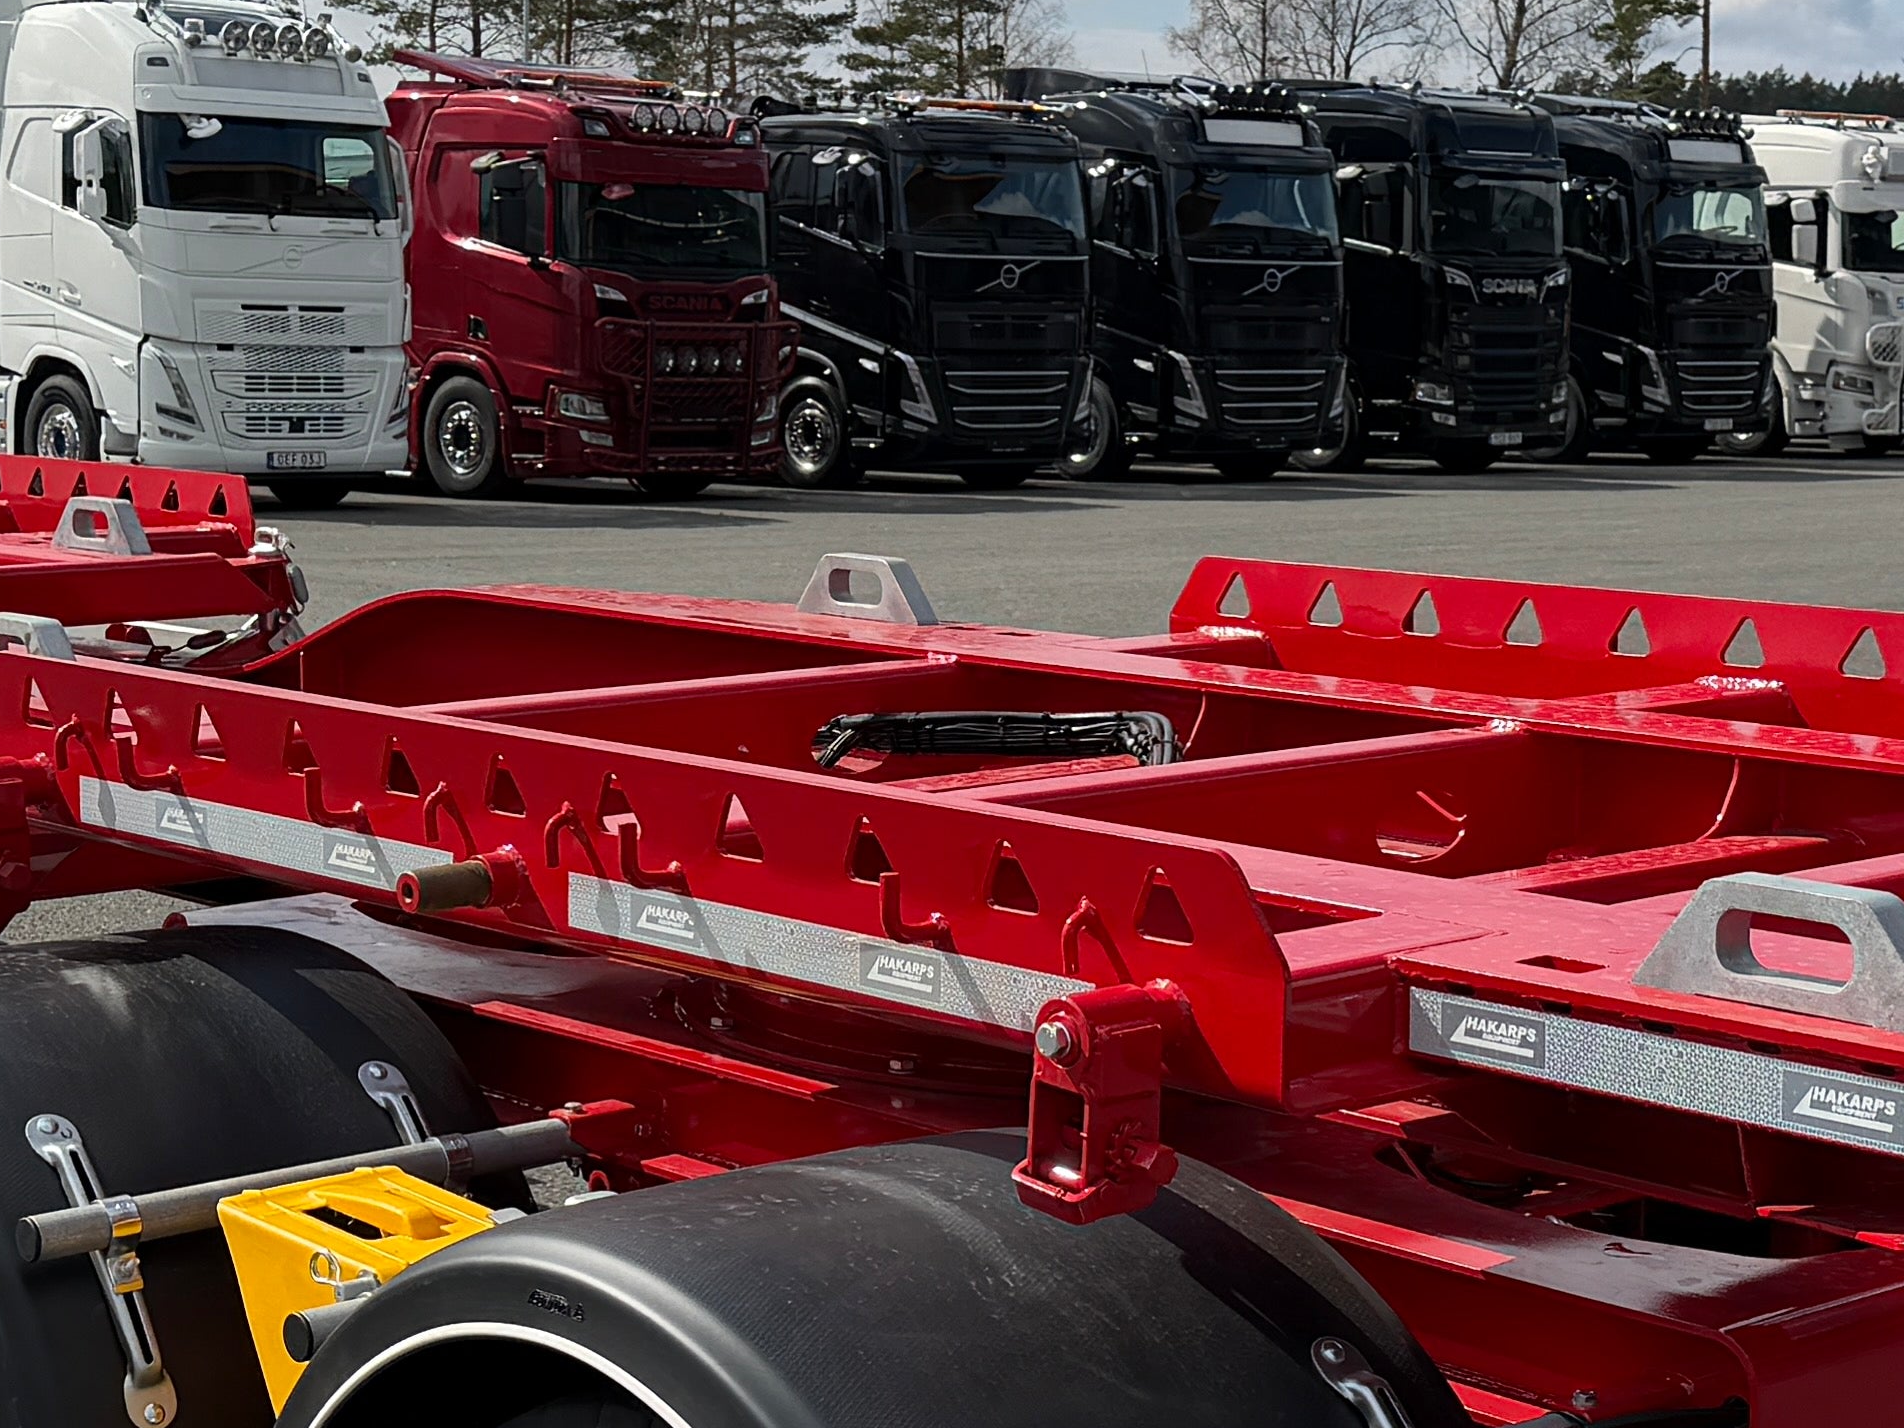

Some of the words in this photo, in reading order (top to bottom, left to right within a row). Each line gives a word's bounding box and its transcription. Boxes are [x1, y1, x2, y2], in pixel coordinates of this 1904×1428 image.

[648, 295, 723, 310] SCANIA
[879, 955, 935, 979] HAKARPS
[1466, 1015, 1537, 1043] HAKARPS
[1812, 1085, 1897, 1117] HAKARPS
